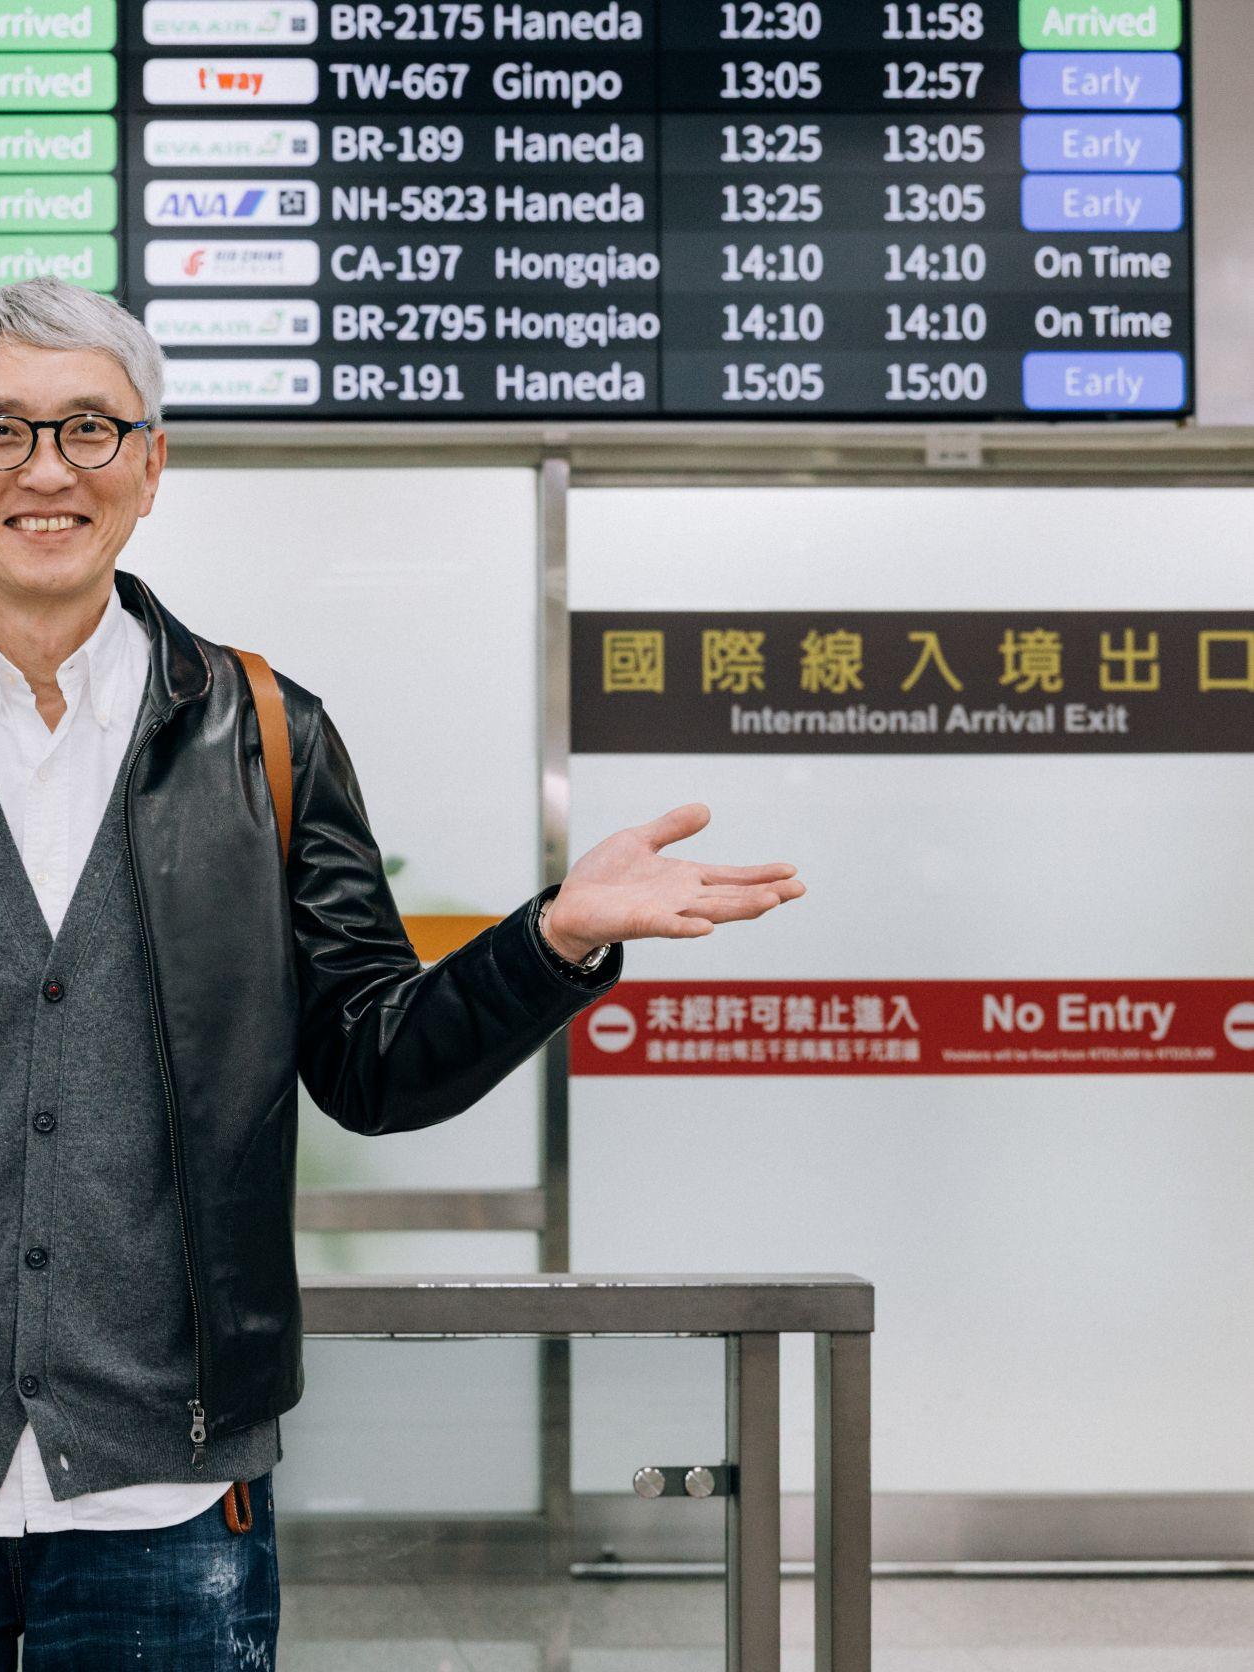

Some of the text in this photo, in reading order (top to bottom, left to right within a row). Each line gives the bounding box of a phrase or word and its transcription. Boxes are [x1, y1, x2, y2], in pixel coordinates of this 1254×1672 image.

[331, 4, 484, 40] BR-2175
[494, 2, 642, 40] Haneda
[720, 2, 821, 39] 12:30
[883, 3, 983, 40] 11:58
[1042, 5, 1157, 37] Arrived
[329, 63, 469, 99] TW-667
[493, 62, 622, 108] Gimpo
[721, 62, 821, 99] 13:05
[883, 62, 984, 99] 12:57
[1062, 66, 1142, 104] Early
[332, 126, 463, 162] BR-189
[496, 124, 643, 162] Haneda
[721, 125, 822, 162] 13:25
[884, 125, 985, 162] 13:05
[1063, 129, 1141, 165] Early
[157, 183, 1142, 225] ANA NH-5823 Haneda 13:25 13:05 Early
[331, 244, 1171, 288] CA-197 Hongqiao 14:10 14:10 On Time
[333, 305, 486, 341] BR-2795
[496, 305, 660, 348] Hongqiao
[722, 304, 824, 341] 14:10
[885, 303, 986, 340] 14:10
[1035, 306, 1082, 338] On
[1089, 306, 1171, 338] Time
[333, 364, 463, 400] BR-191
[497, 362, 645, 401] Haneda
[722, 363, 824, 401] 15:05
[886, 363, 987, 400] 15:00
[1064, 366, 1143, 401] Early
[603, 629, 1254, 693] 國際線入境出口
[731, 704, 1128, 733] International Arrival Exit
[648, 996, 918, 1032] 未經許可禁止進入
[983, 994, 1175, 1040] No Entry
